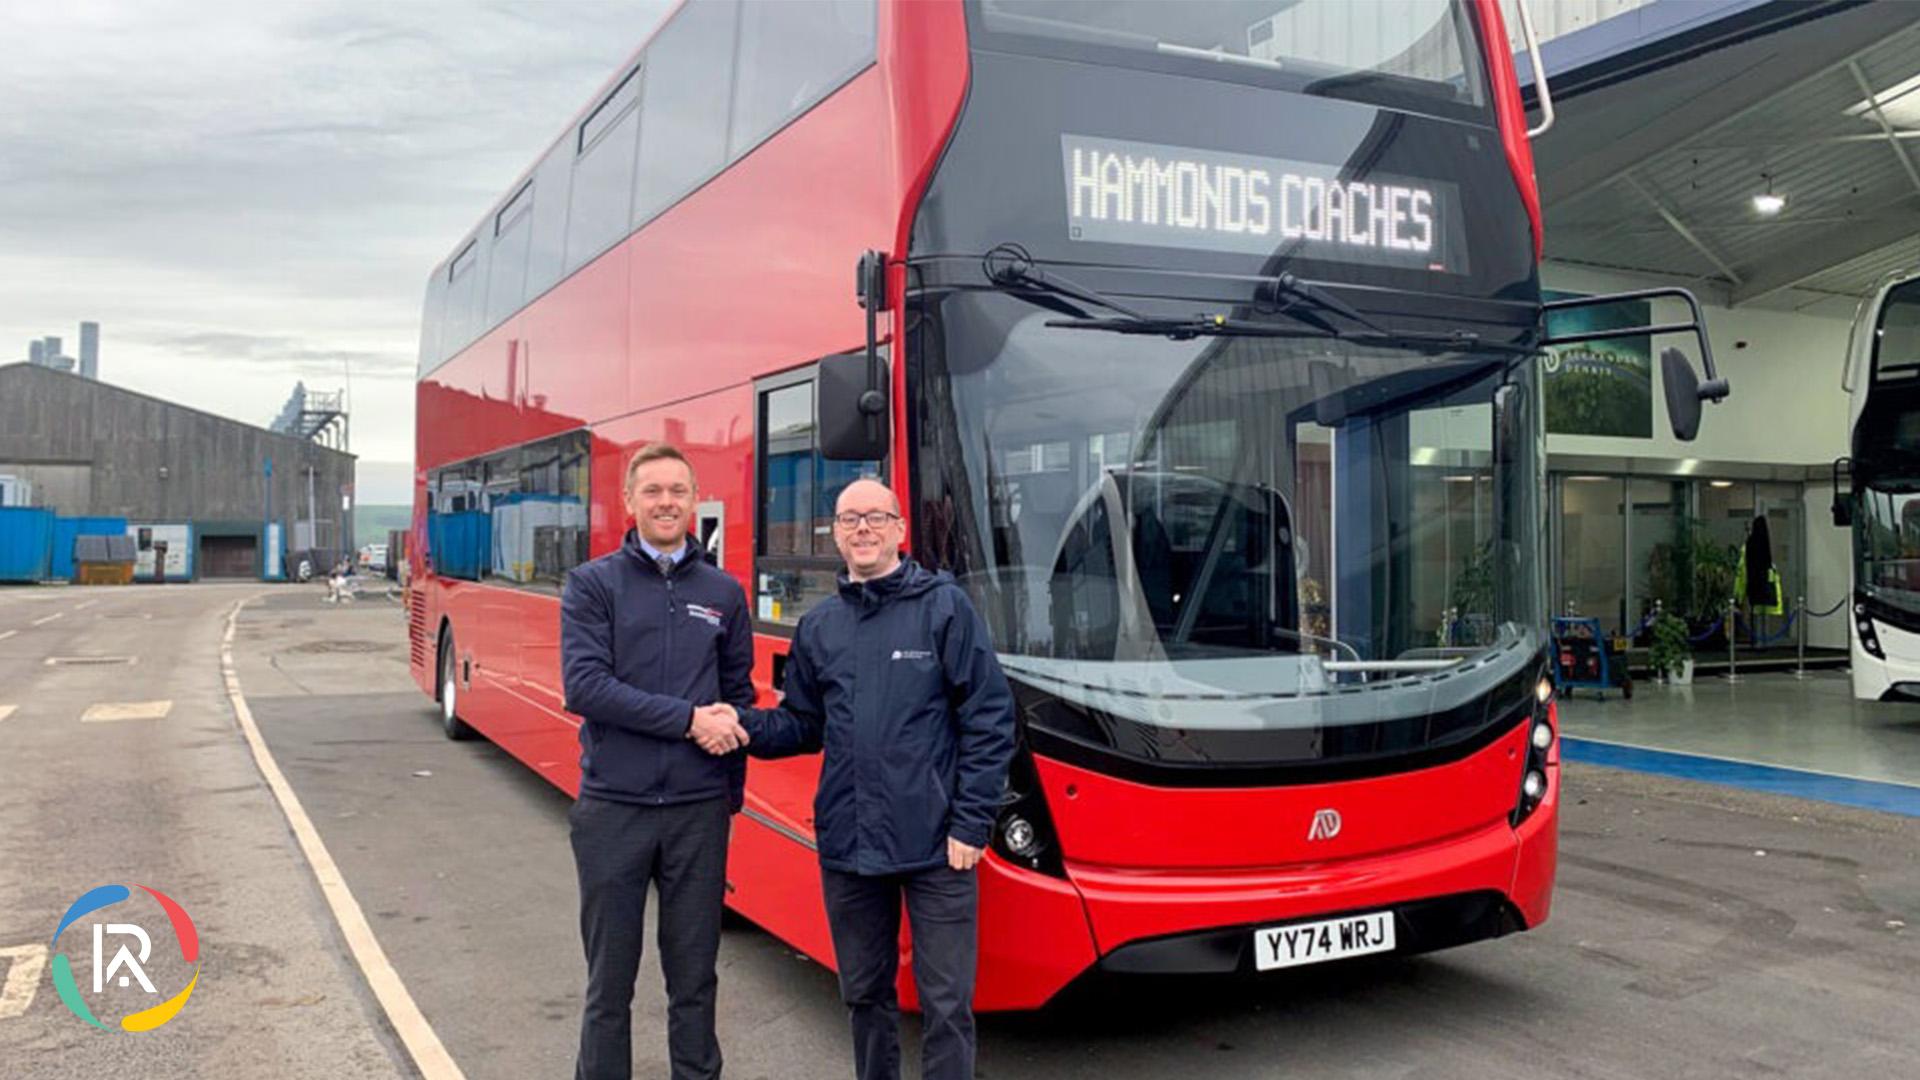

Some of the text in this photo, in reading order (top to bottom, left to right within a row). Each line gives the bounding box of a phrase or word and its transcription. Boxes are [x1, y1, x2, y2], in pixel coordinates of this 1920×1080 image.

[1073, 148, 1434, 251] HAMMONDS COACHES
[1268, 917, 1385, 962] YY74 WRJ
